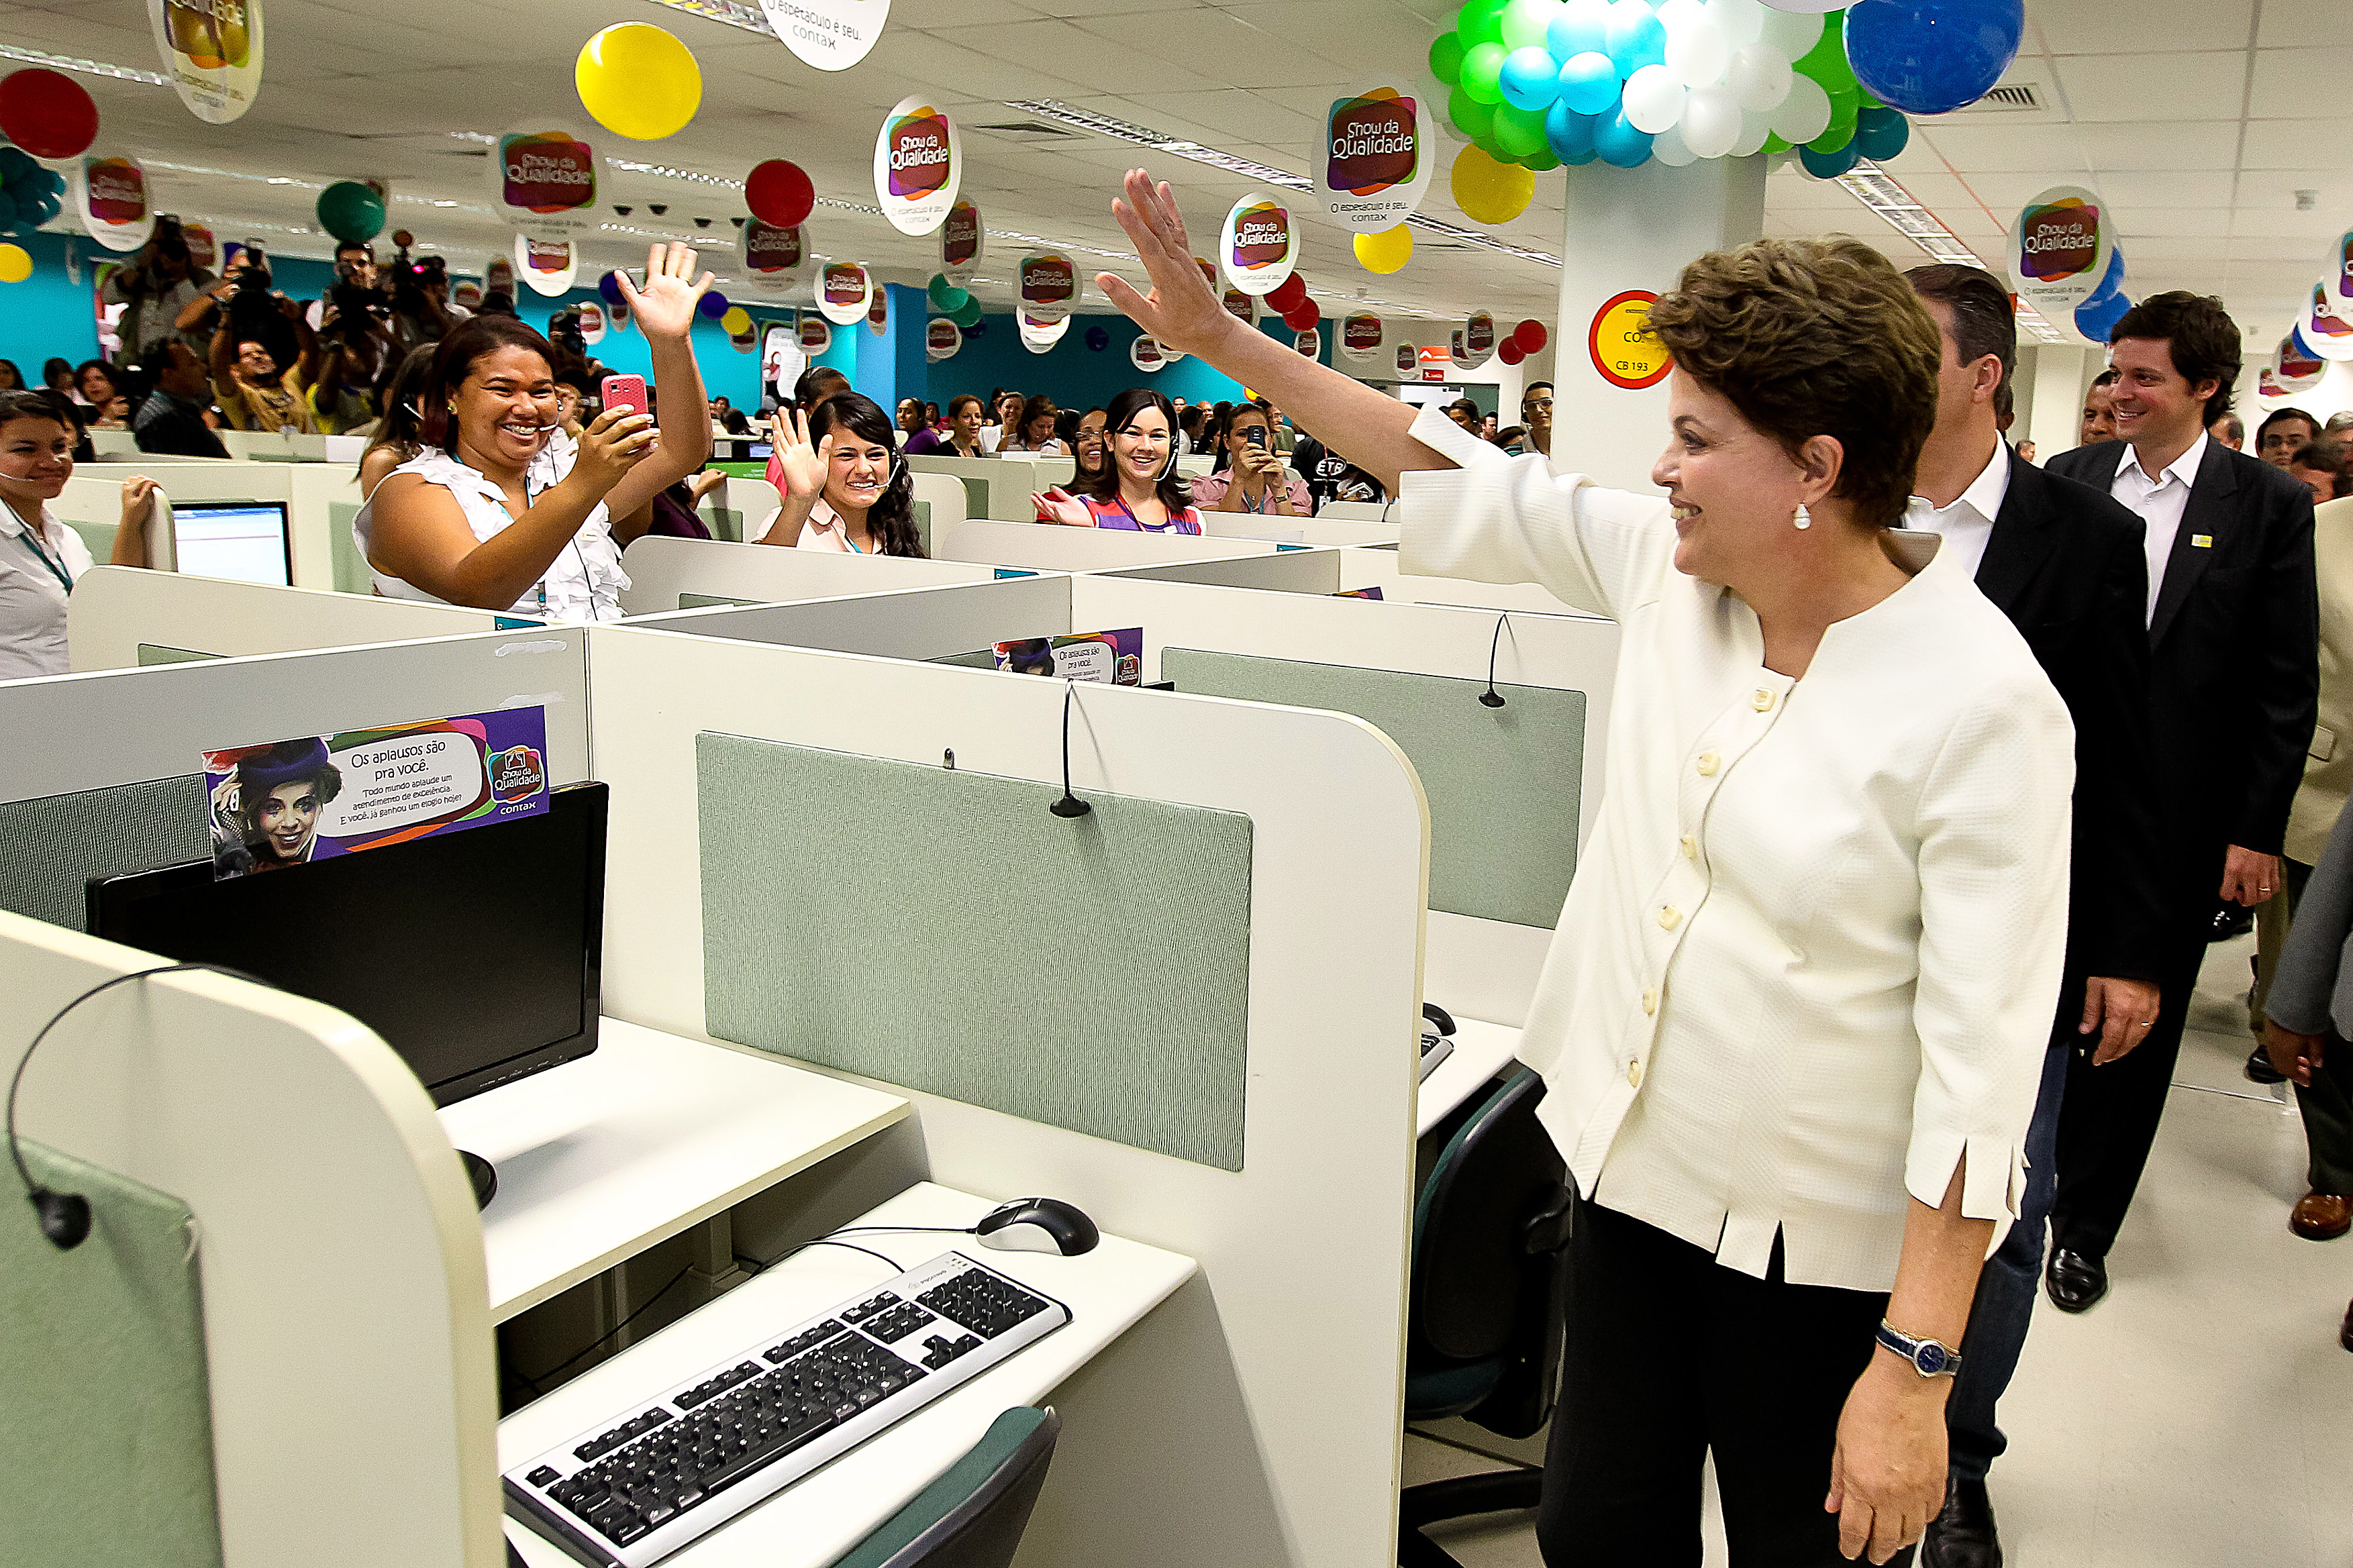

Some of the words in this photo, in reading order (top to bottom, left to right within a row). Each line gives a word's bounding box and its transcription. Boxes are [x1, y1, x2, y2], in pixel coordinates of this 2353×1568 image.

[779, 1, 832, 30] espetáculo
[834, 18, 840, 33] é
[842, 24, 862, 41] seu.
[792, 25, 837, 50] contax
[1347, 121, 1383, 138] Show
[1384, 119, 1399, 134] da
[900, 135, 926, 153] Show
[926, 134, 938, 148] da
[1332, 134, 1414, 160] Qualidade
[890, 147, 948, 170] Qualidade
[1234, 231, 1287, 248] Qualidade
[2025, 234, 2095, 254] Qualidade
[1616, 360, 1629, 370] CB
[1632, 362, 1648, 371] 193
[352, 753, 369, 768] Os
[372, 745, 423, 764] aplausos
[425, 740, 446, 755] são
[374, 768, 395, 782] pra
[397, 758, 429, 776] você.
[501, 770, 521, 781] Show
[522, 767, 532, 776] da
[362, 787, 383, 798] Todo
[385, 782, 411, 793] mundo
[411, 776, 440, 789] aplaude
[494, 773, 541, 791] Qualidade
[352, 795, 401, 811] atendimento
[401, 792, 411, 801] de
[412, 785, 452, 798] excelência.
[499, 801, 537, 815] contax
[340, 817, 348, 825] E
[370, 809, 378, 820] já
[379, 805, 407, 817] ganhou
[408, 802, 420, 811] um
[421, 798, 443, 808] elogio
[444, 794, 462, 805] hoje?
